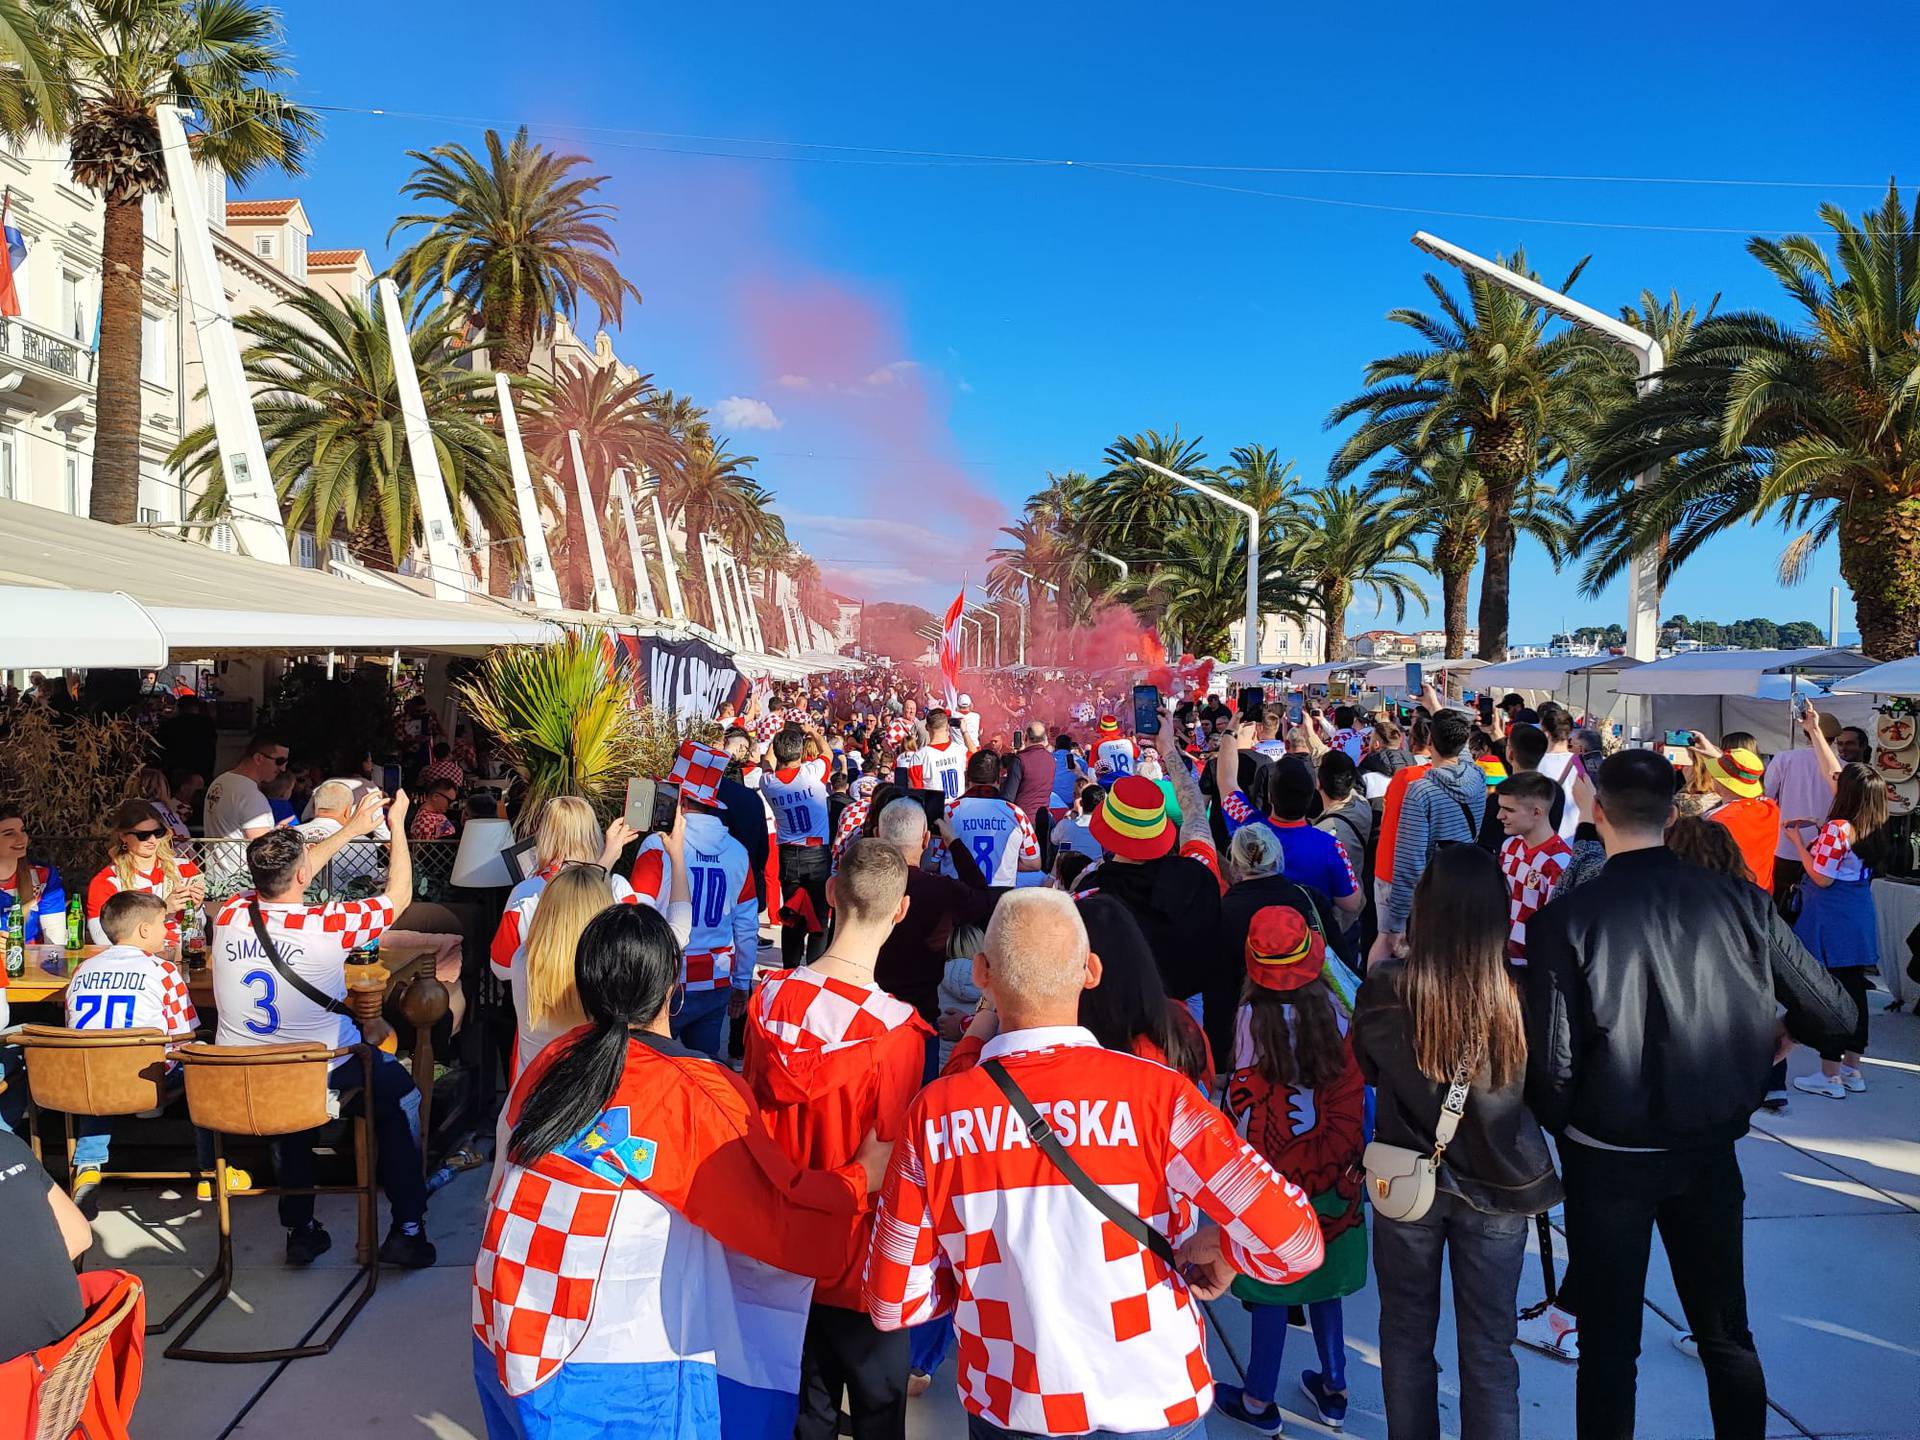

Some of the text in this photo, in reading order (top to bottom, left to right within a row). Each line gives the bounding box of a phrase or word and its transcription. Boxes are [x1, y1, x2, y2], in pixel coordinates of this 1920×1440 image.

[1110, 753, 1130, 772] 18
[939, 769, 959, 799] 10
[784, 805, 812, 834] 10
[973, 836, 995, 885] 8
[689, 866, 727, 928] 10
[72, 972, 147, 992] GVARDIOL
[75, 995, 136, 1029] 20
[240, 968, 281, 1036] 3
